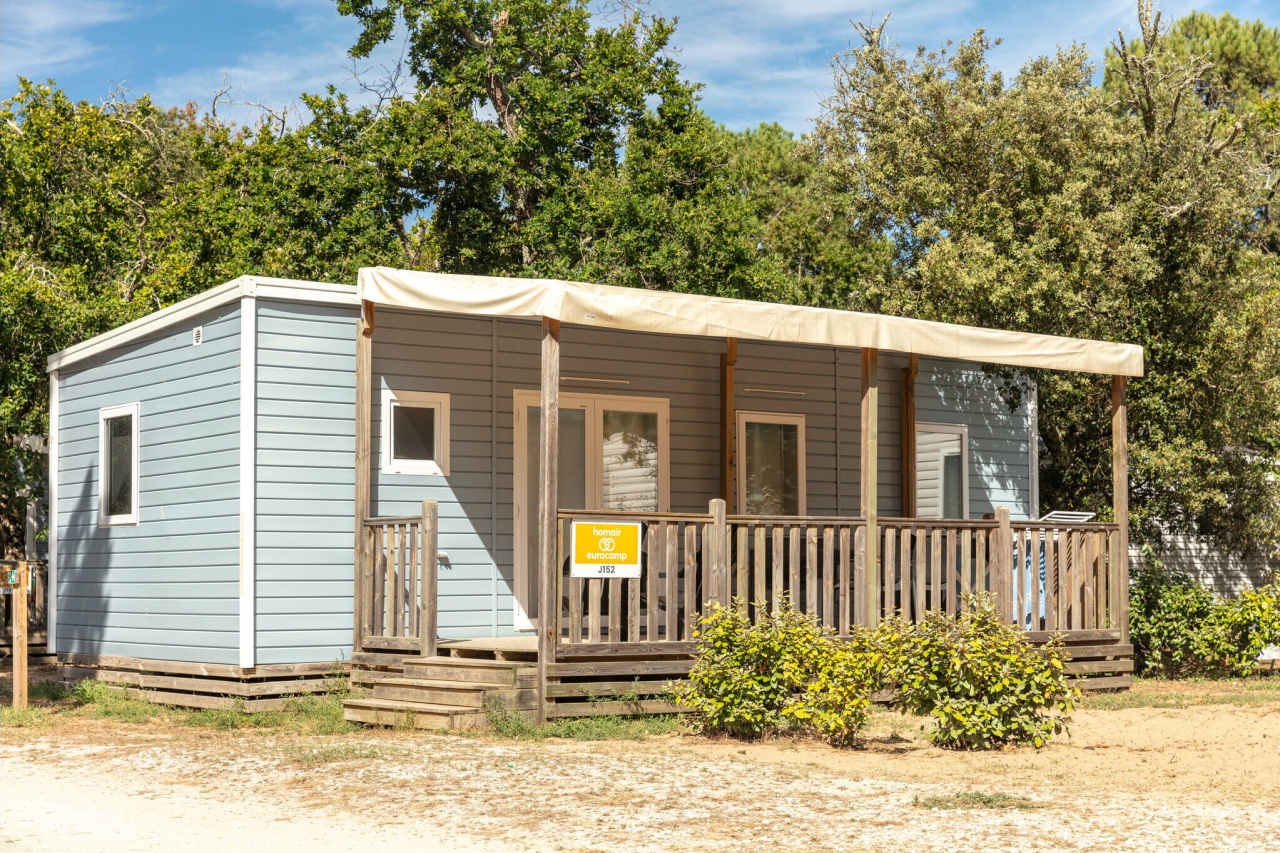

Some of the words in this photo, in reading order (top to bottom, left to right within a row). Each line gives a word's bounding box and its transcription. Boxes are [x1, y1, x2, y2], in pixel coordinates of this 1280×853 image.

[592, 527, 622, 536] homair
[586, 552, 628, 561] eurocamp
[598, 565, 616, 574] J152
